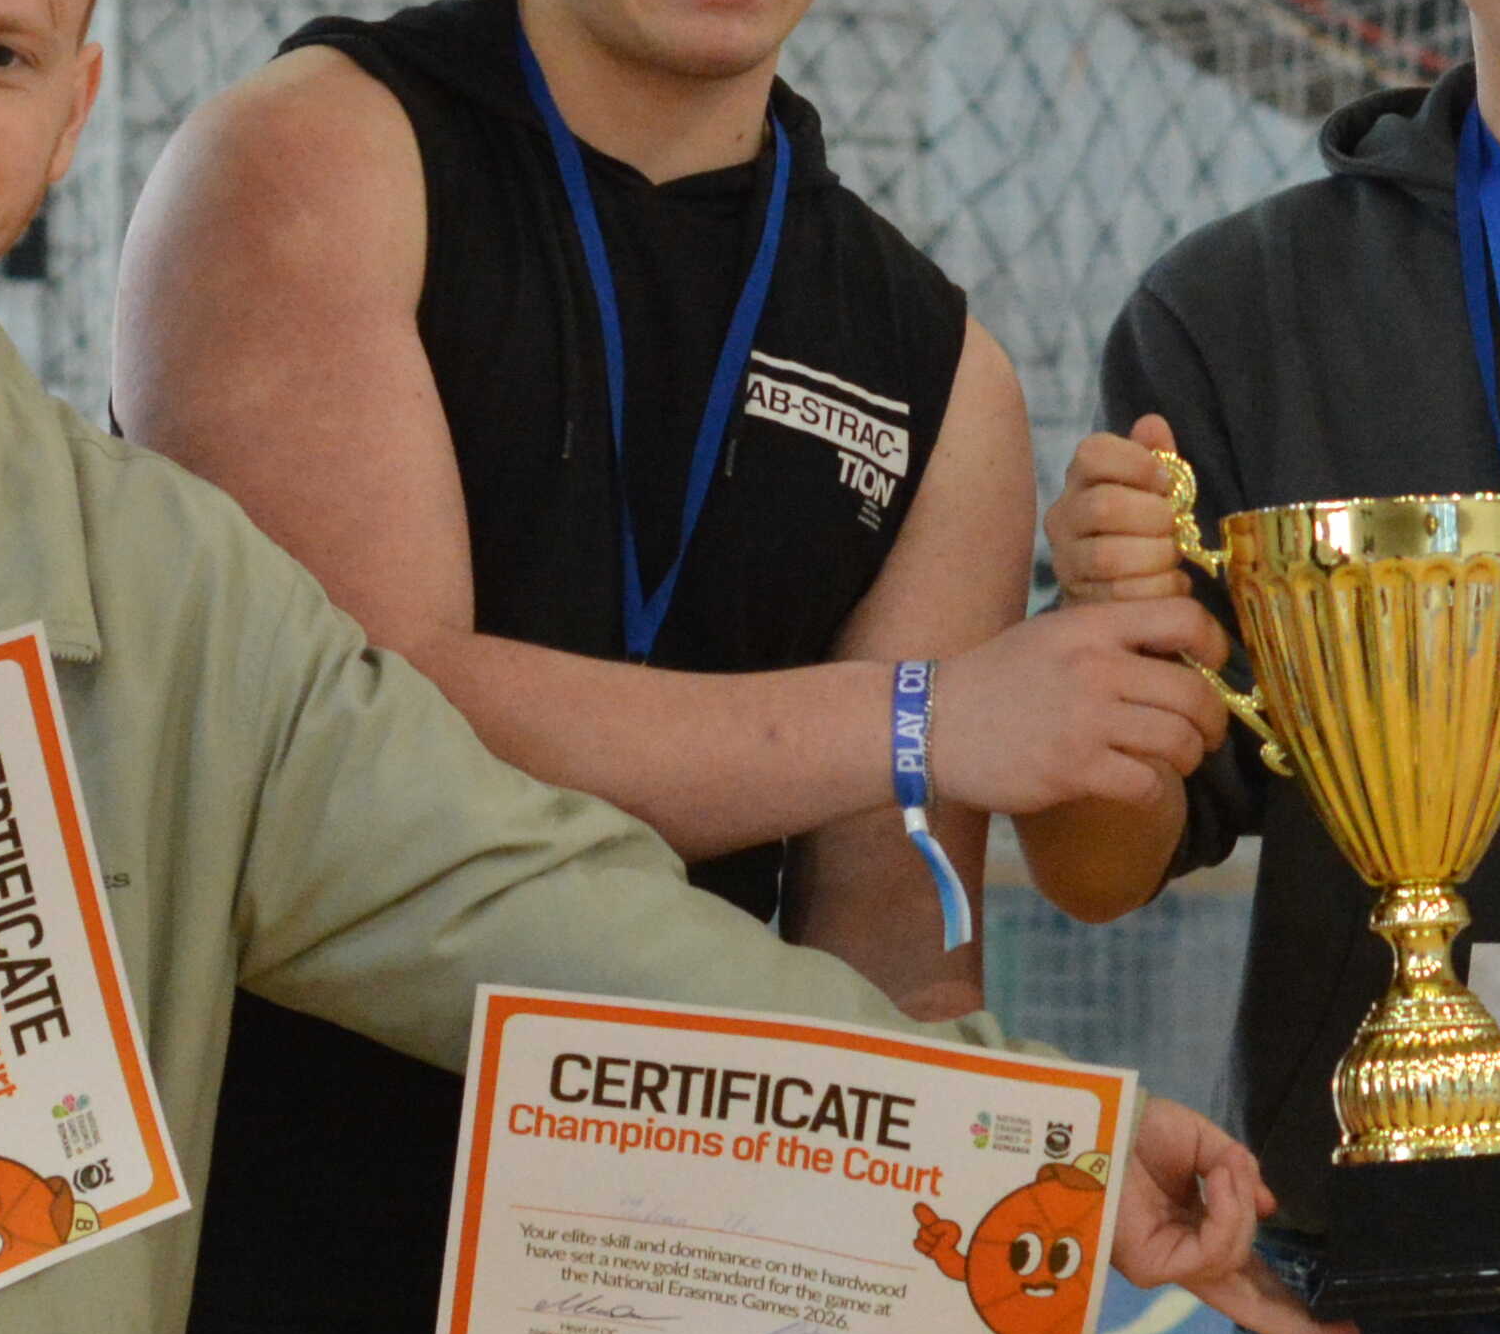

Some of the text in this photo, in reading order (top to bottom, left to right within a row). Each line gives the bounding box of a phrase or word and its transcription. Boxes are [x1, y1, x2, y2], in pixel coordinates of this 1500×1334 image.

[746, 380, 903, 459] AB-STRAC-
[837, 450, 897, 508] TION
[897, 709, 926, 773] PLAY
[550, 1053, 915, 1150] CERTIFICATE
[509, 1104, 943, 1196] Champions of the Court
[1090, 1158, 1106, 1174] B
[74, 1213, 94, 1235] B
[520, 1223, 907, 1299] Your elite skill and dominance on the hardwood
[526, 1243, 891, 1316] have set a new gold standard for the game at
[562, 1267, 849, 1331] the National Erasmus Games 2026.
